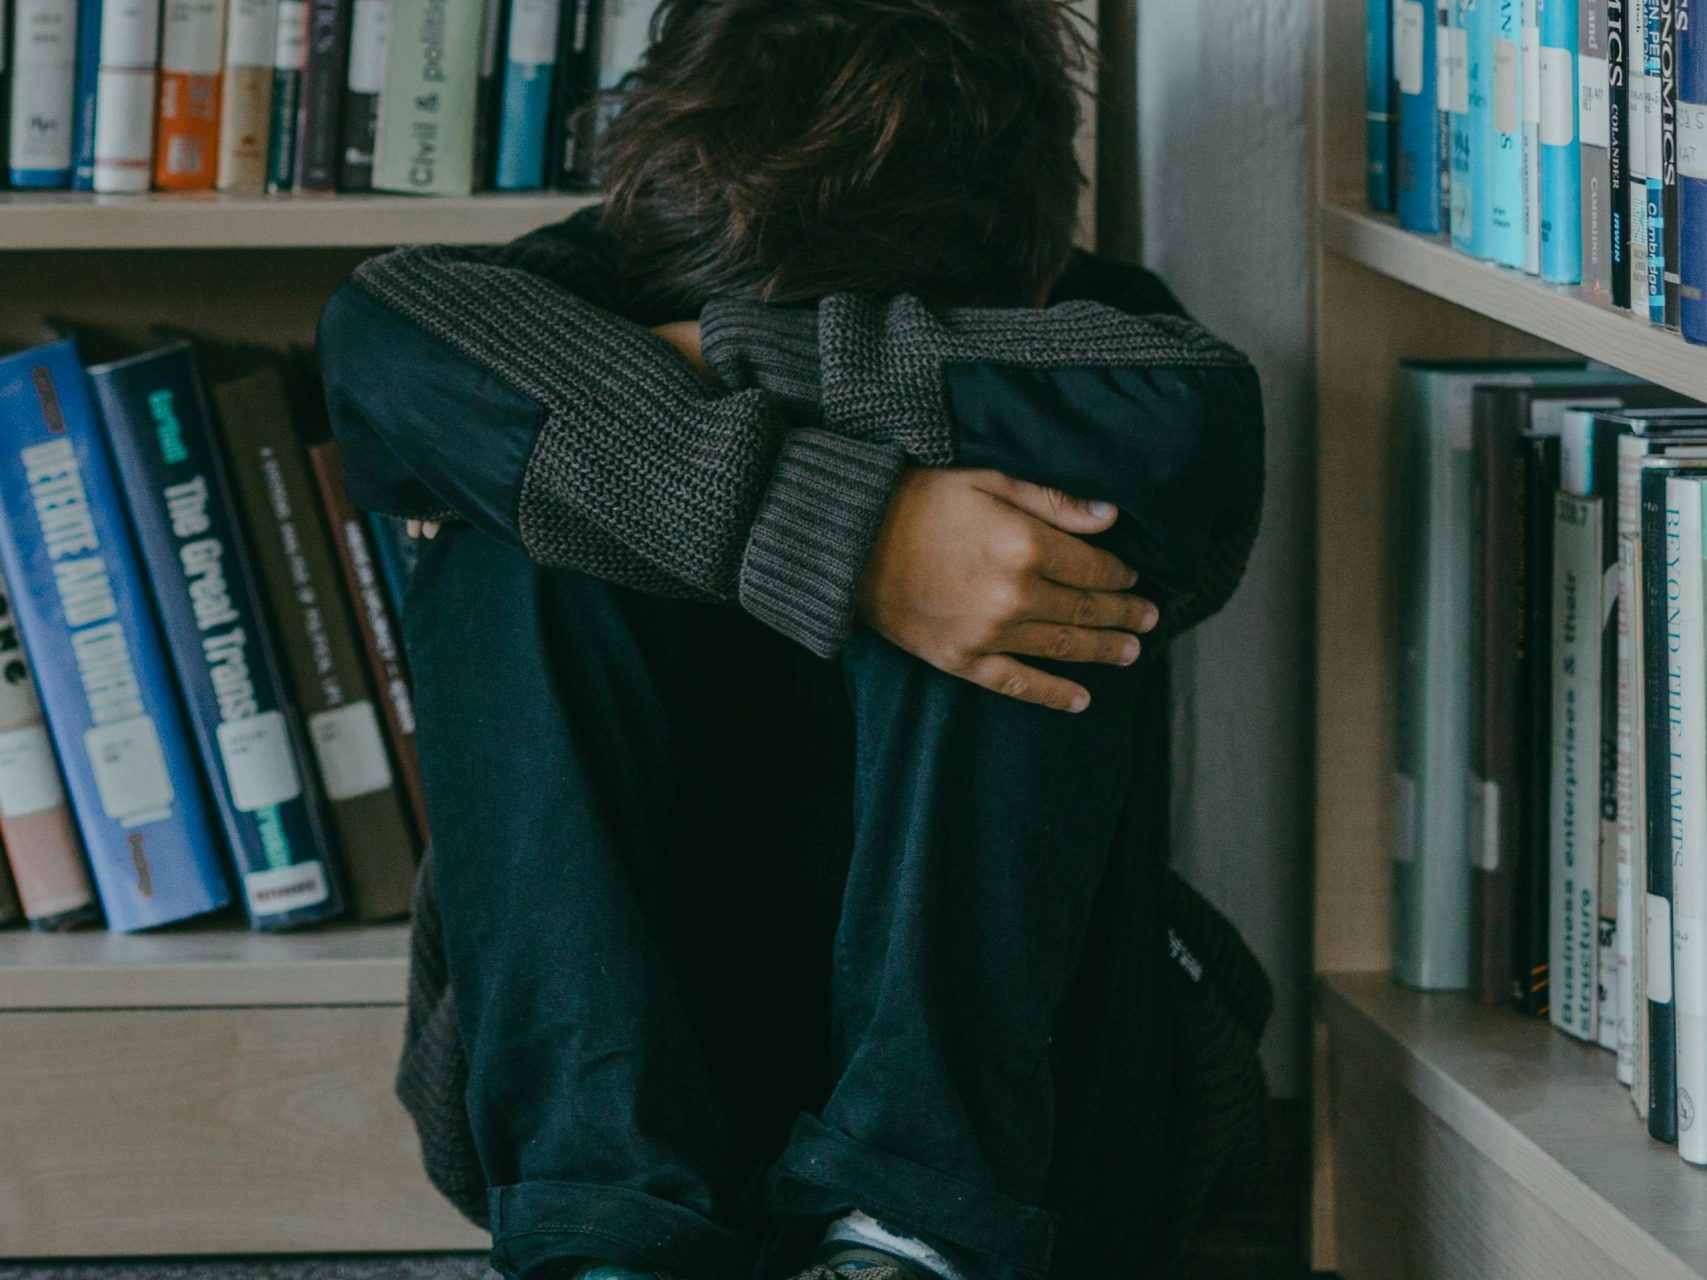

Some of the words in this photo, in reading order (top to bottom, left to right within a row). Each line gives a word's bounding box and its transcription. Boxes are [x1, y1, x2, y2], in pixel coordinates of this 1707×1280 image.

[1588, 9, 1599, 49] and
[414, 93, 439, 114] &
[1610, 103, 1620, 190] COLANDER
[408, 123, 438, 189] Civil
[1590, 176, 1599, 265] CAMBRIDGE
[1612, 211, 1621, 263] IRWIN
[1647, 202, 1658, 296] Cambridge
[17, 436, 100, 561] DETENTE
[159, 474, 217, 540] The
[51, 553, 118, 628] AND
[174, 535, 241, 631] Great
[1564, 571, 1577, 645] their
[1666, 505, 1682, 657] BEYOND
[1564, 654, 1577, 678] &
[1668, 664, 1683, 738] THE
[1562, 688, 1578, 869] enterprises
[1671, 749, 1686, 867] LIMITS
[1562, 879, 1575, 1026] Business
[1579, 890, 1594, 1035] structure
